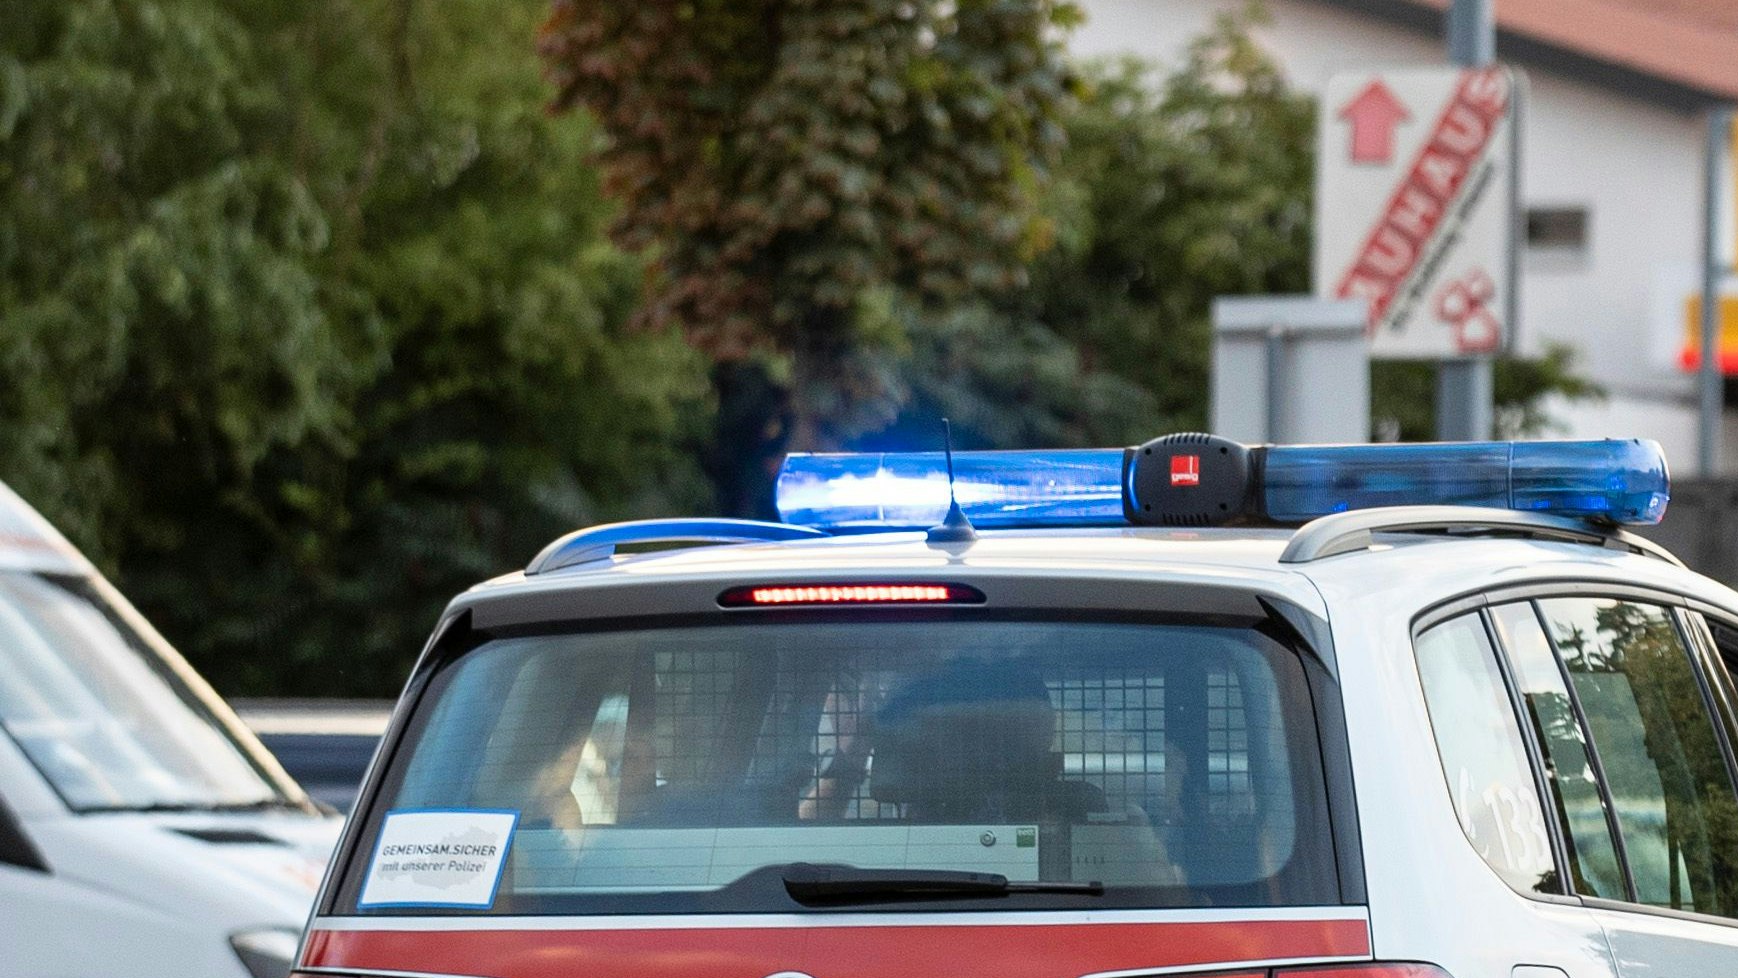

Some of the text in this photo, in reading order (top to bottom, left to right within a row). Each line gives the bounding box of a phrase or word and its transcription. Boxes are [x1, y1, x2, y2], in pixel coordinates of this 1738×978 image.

[1336, 68, 1508, 331] AUHAUS
[382, 844, 497, 857] GEMEINSAM.SICHER
[382, 861, 486, 873] mit unserer Polizei
